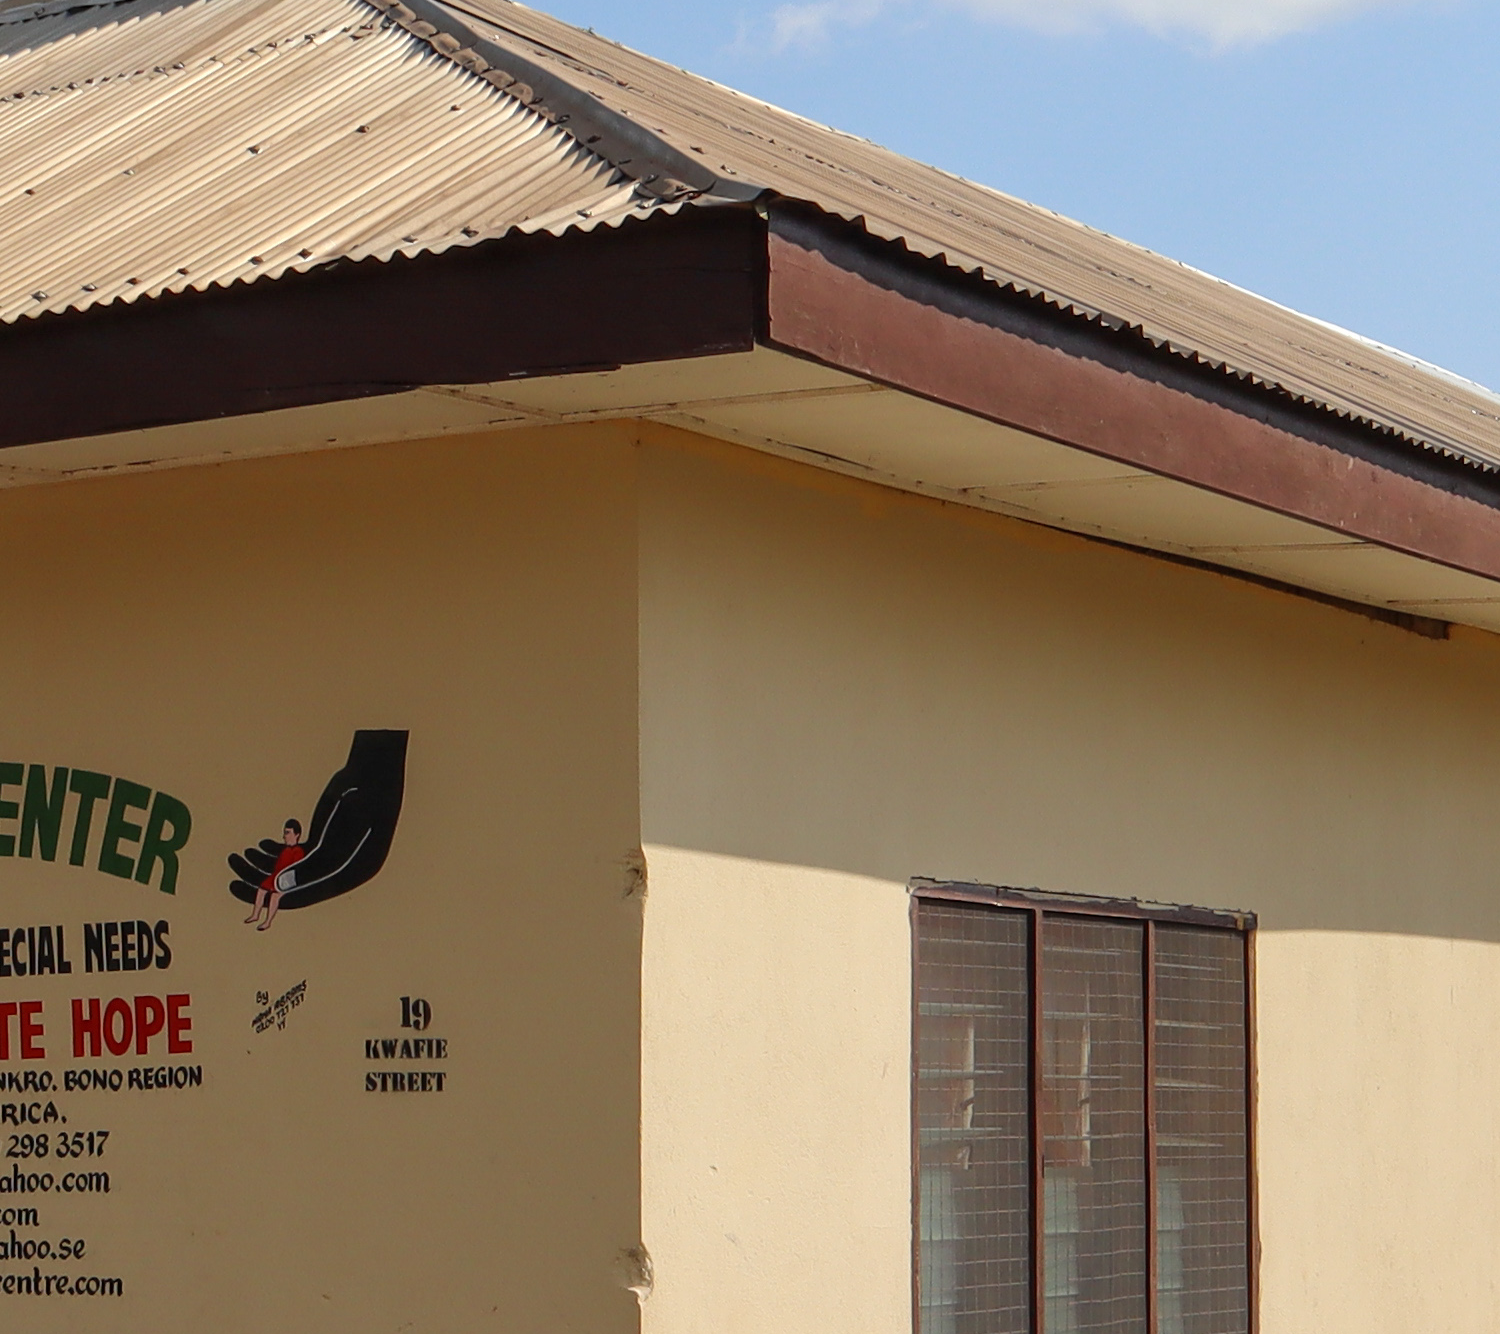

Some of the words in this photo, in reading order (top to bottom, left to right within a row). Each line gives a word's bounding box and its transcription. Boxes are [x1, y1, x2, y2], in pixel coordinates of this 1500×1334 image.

[83, 920, 172, 973] NEEDS
[256, 990, 269, 1006] By
[71, 994, 193, 1058] HOPE
[399, 996, 432, 1031] 19
[365, 1038, 448, 1059] KWAFIE
[63, 1068, 123, 1092] BONO
[128, 1065, 203, 1091] REGION
[365, 1071, 447, 1092] STREET
[5, 1133, 49, 1159] 298
[55, 1131, 110, 1159] 3517
